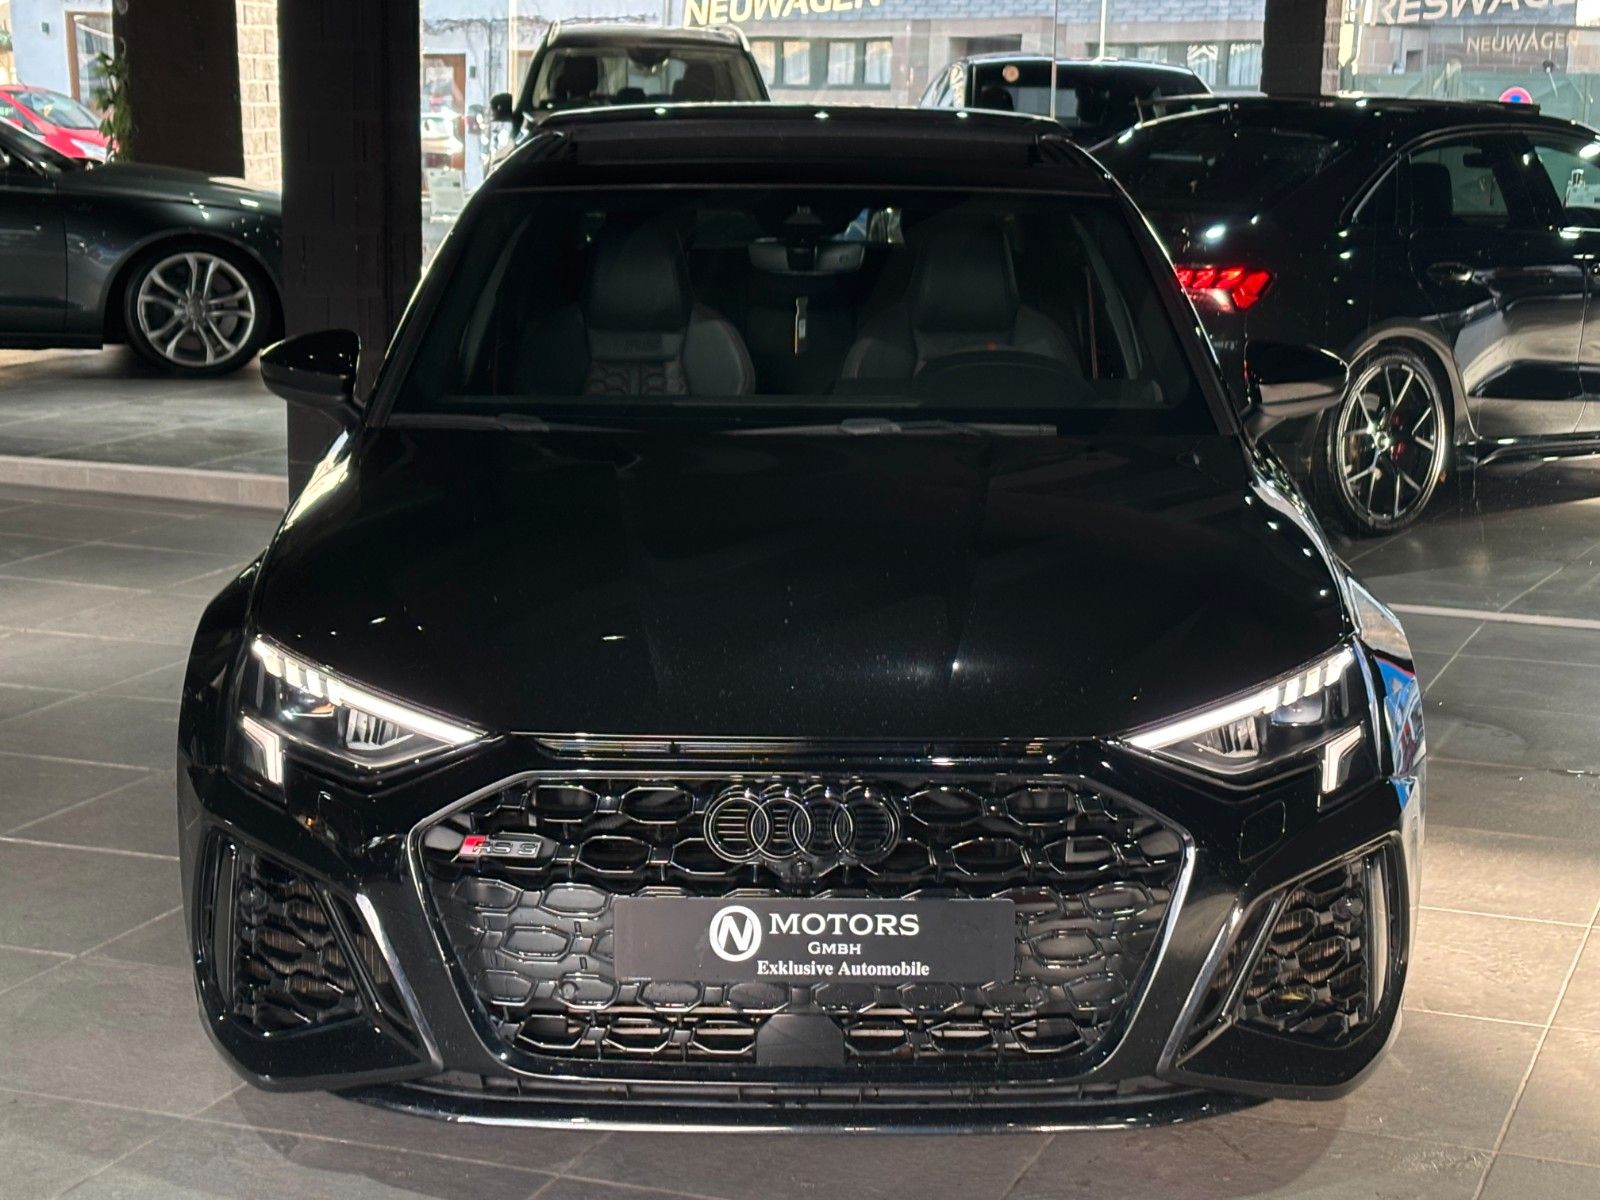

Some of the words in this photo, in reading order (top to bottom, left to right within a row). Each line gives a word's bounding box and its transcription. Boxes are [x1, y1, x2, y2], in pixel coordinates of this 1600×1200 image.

[683, 0, 880, 28] NEUWAG
[1466, 29, 1580, 53] NEUWAGEN
[768, 912, 920, 936] MOTORS
[807, 941, 862, 955] GMBH
[756, 960, 834, 976] Exklusive
[838, 960, 930, 977] Automobile
